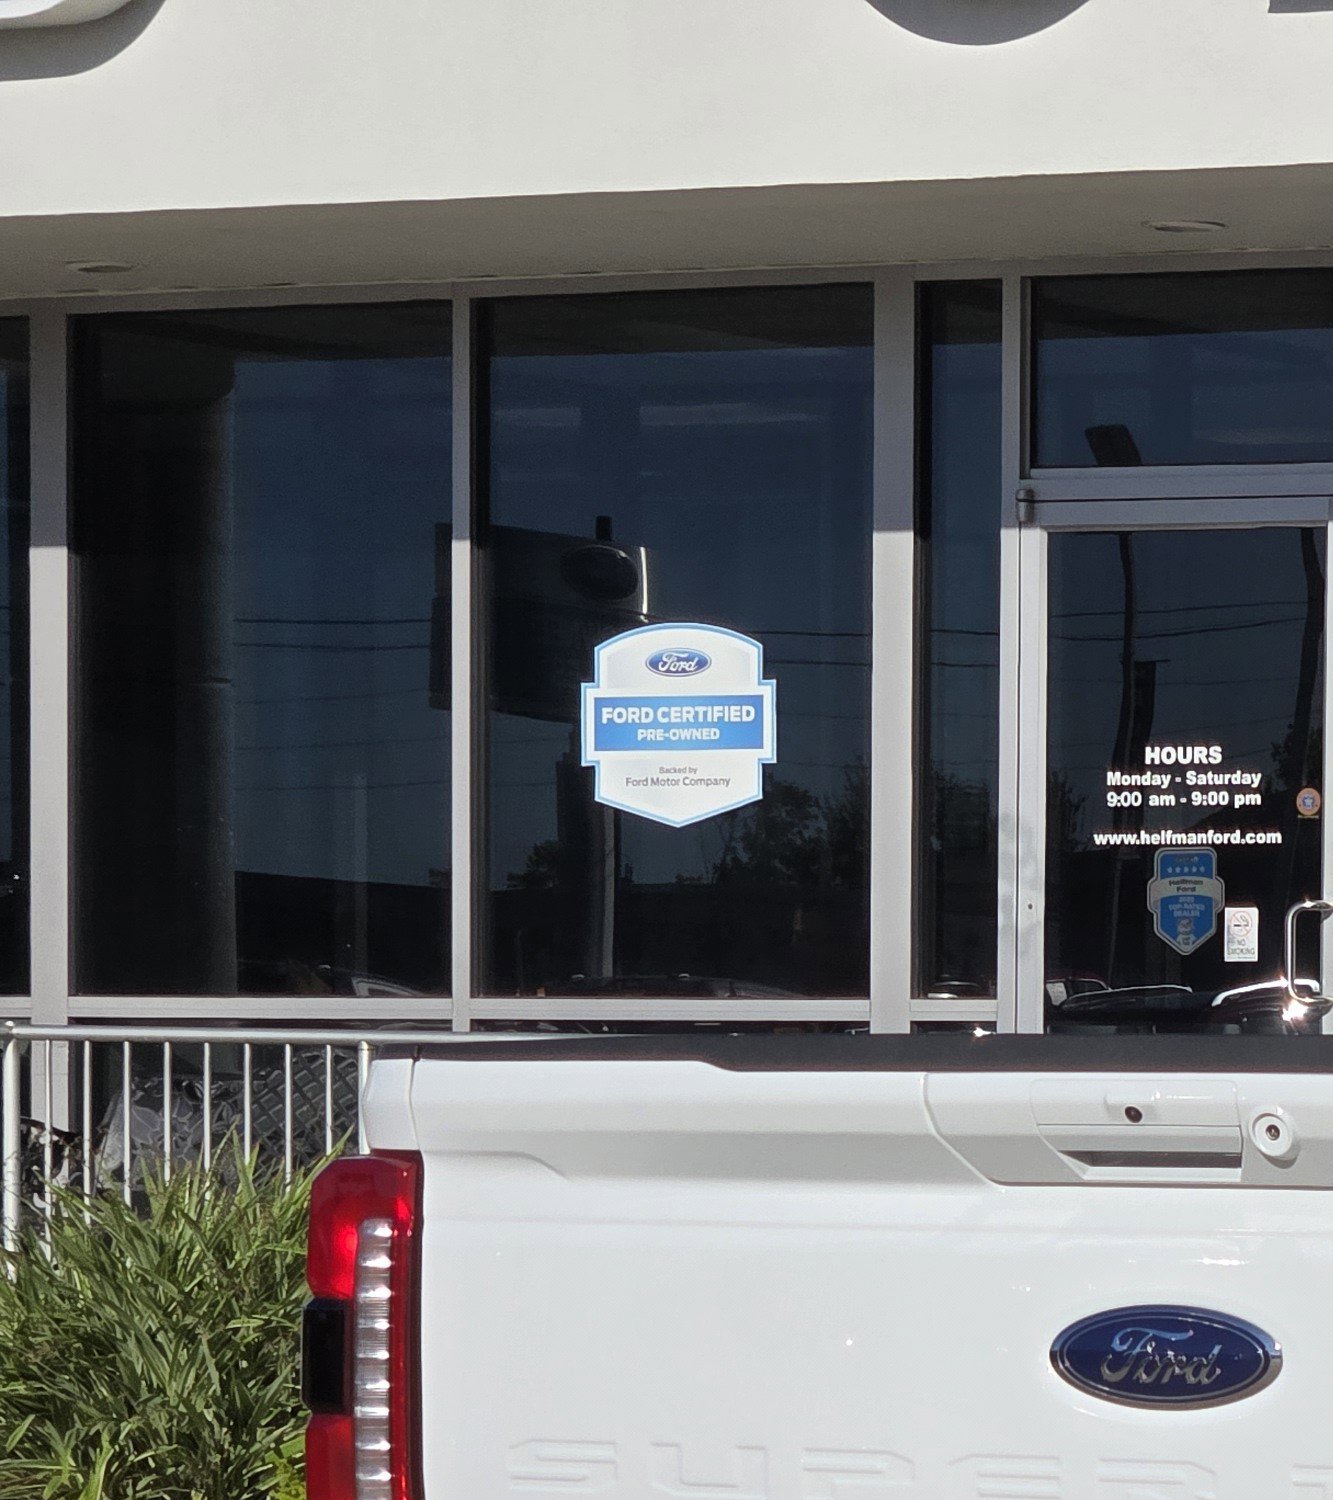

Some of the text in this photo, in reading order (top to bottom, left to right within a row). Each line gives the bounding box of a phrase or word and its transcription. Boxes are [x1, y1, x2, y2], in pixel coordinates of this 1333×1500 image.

[659, 651, 698, 672] Ford
[602, 705, 756, 724] FORD CERTIFIED
[637, 728, 720, 741] PRE-OWNED
[1145, 746, 1223, 765] HOURS
[659, 766, 698, 775] Backed by
[1107, 771, 1171, 788] Monday
[1186, 770, 1262, 787] Saturday
[625, 777, 731, 789] Ford Motor Company
[1107, 791, 1142, 807] 9:00
[1148, 793, 1175, 806] am
[1191, 791, 1229, 806] 9:00
[1234, 792, 1262, 808] pm
[1094, 830, 1282, 845] www.helfmanford.com
[1100, 1327, 1222, 1384] Ford
